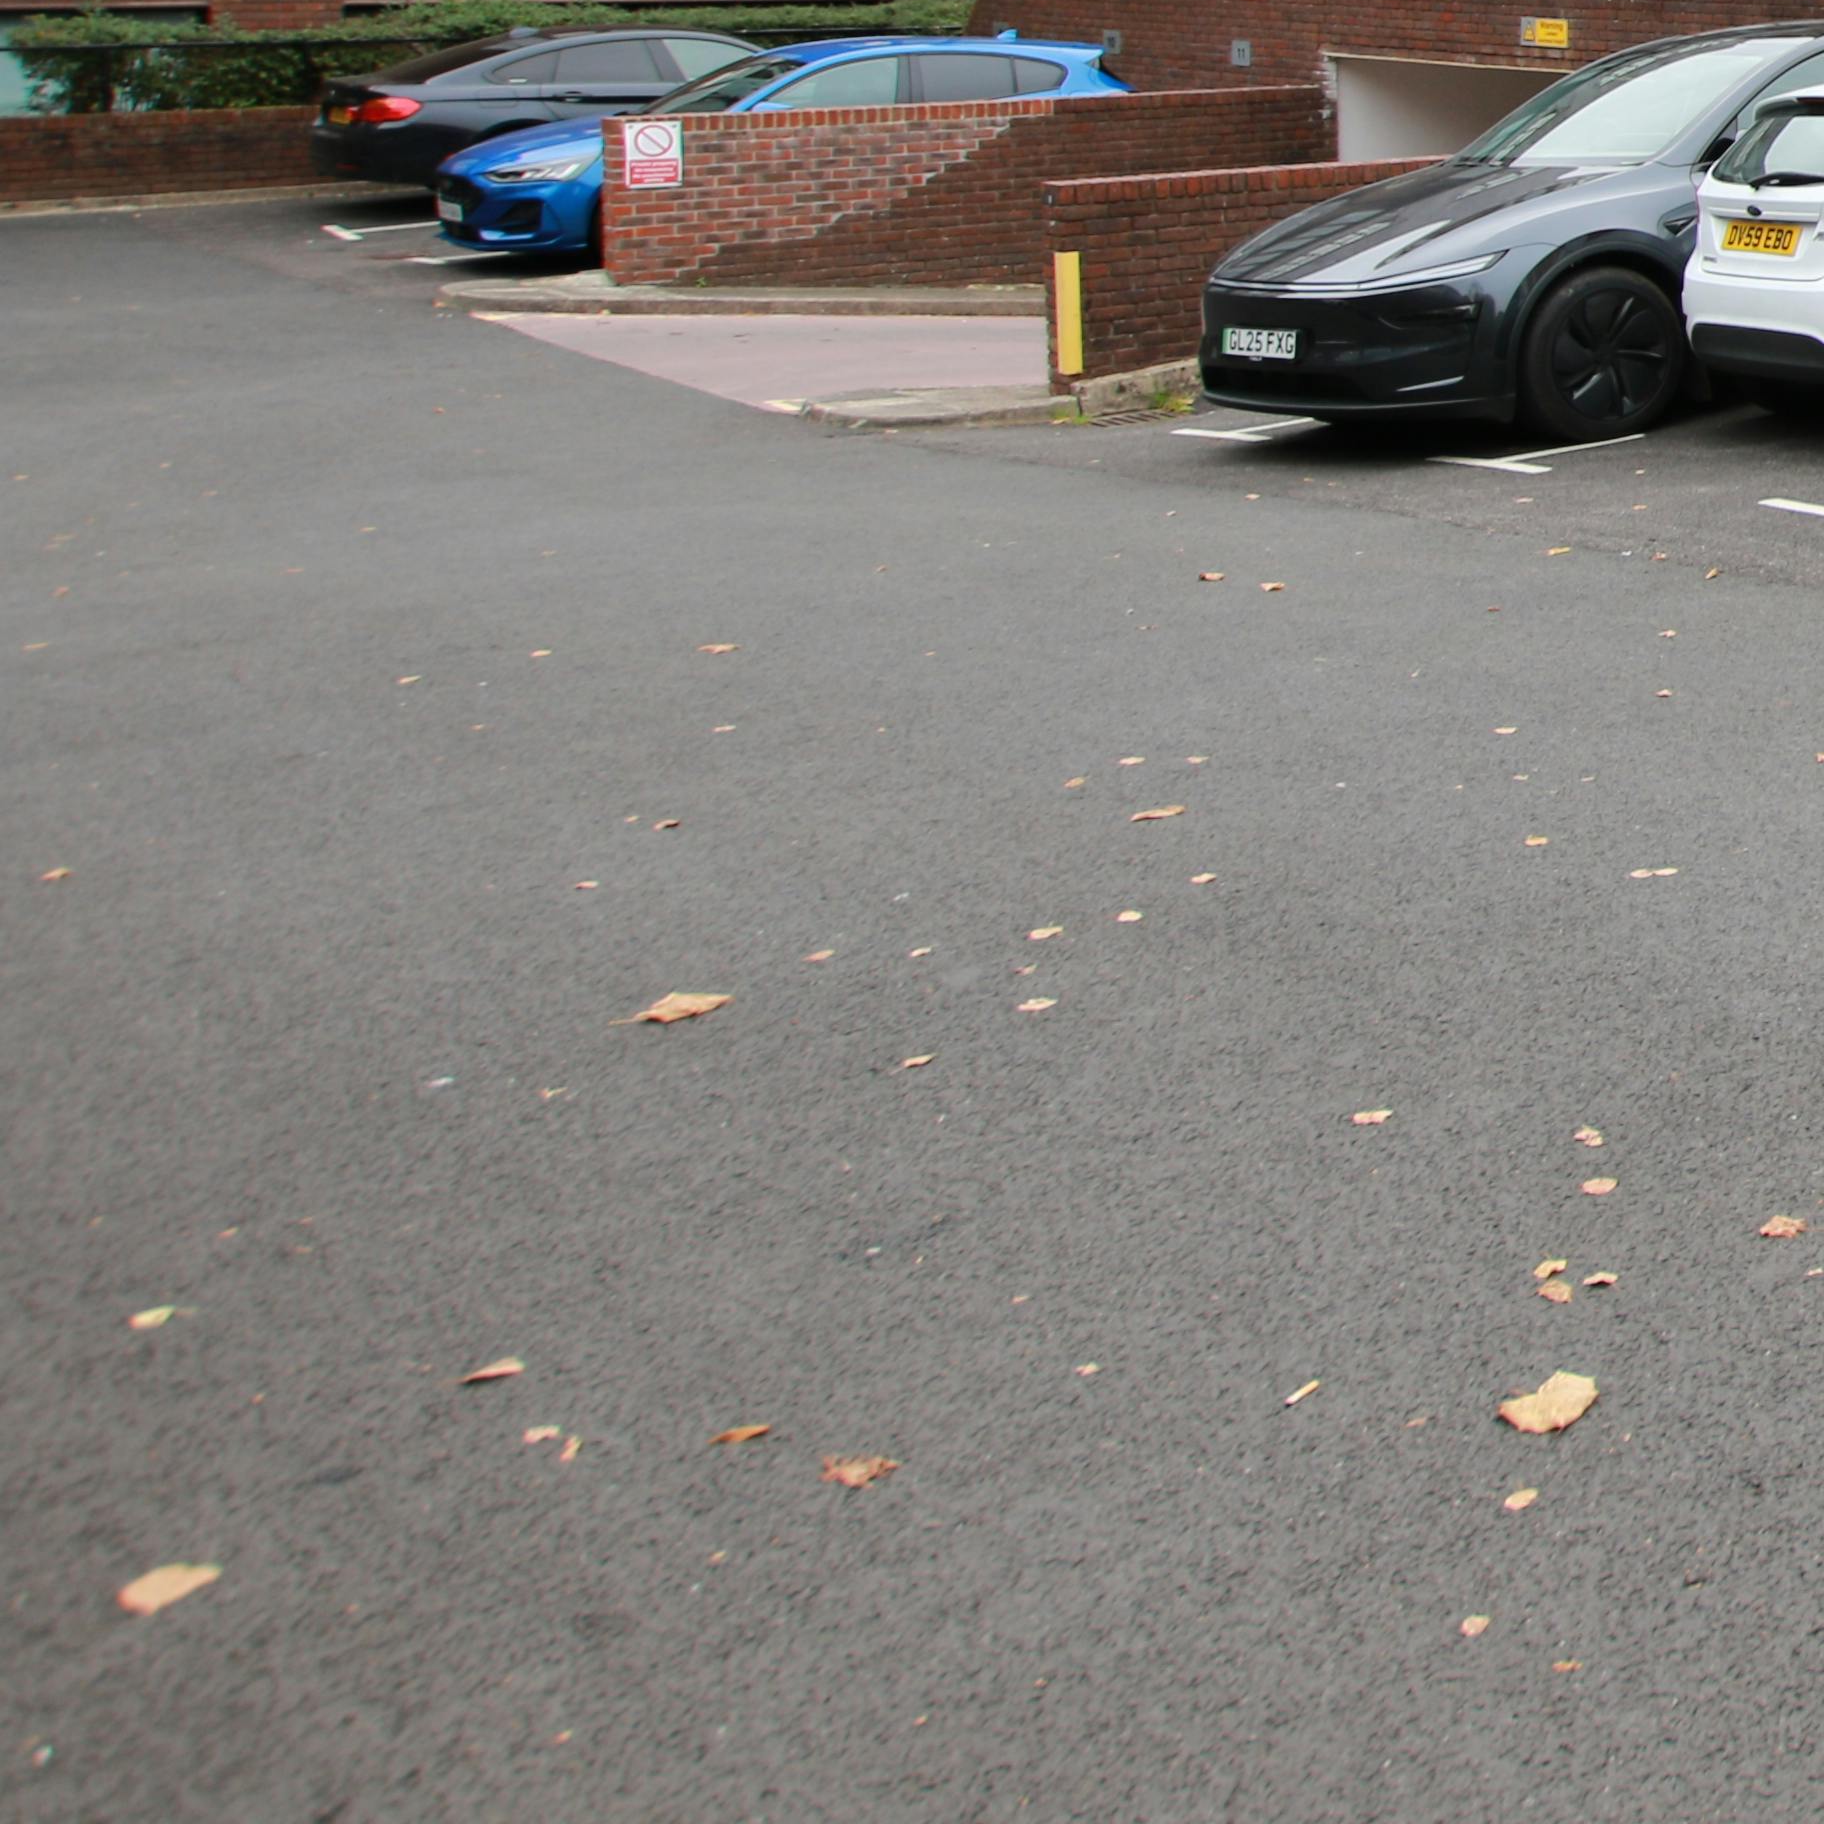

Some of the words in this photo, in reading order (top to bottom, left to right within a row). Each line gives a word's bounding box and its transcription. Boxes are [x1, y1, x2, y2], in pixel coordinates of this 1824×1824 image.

[1237, 47, 1246, 58] 11
[1727, 225, 1763, 248] DV59
[1229, 329, 1263, 352] GL25
[1266, 332, 1294, 354] FXG
